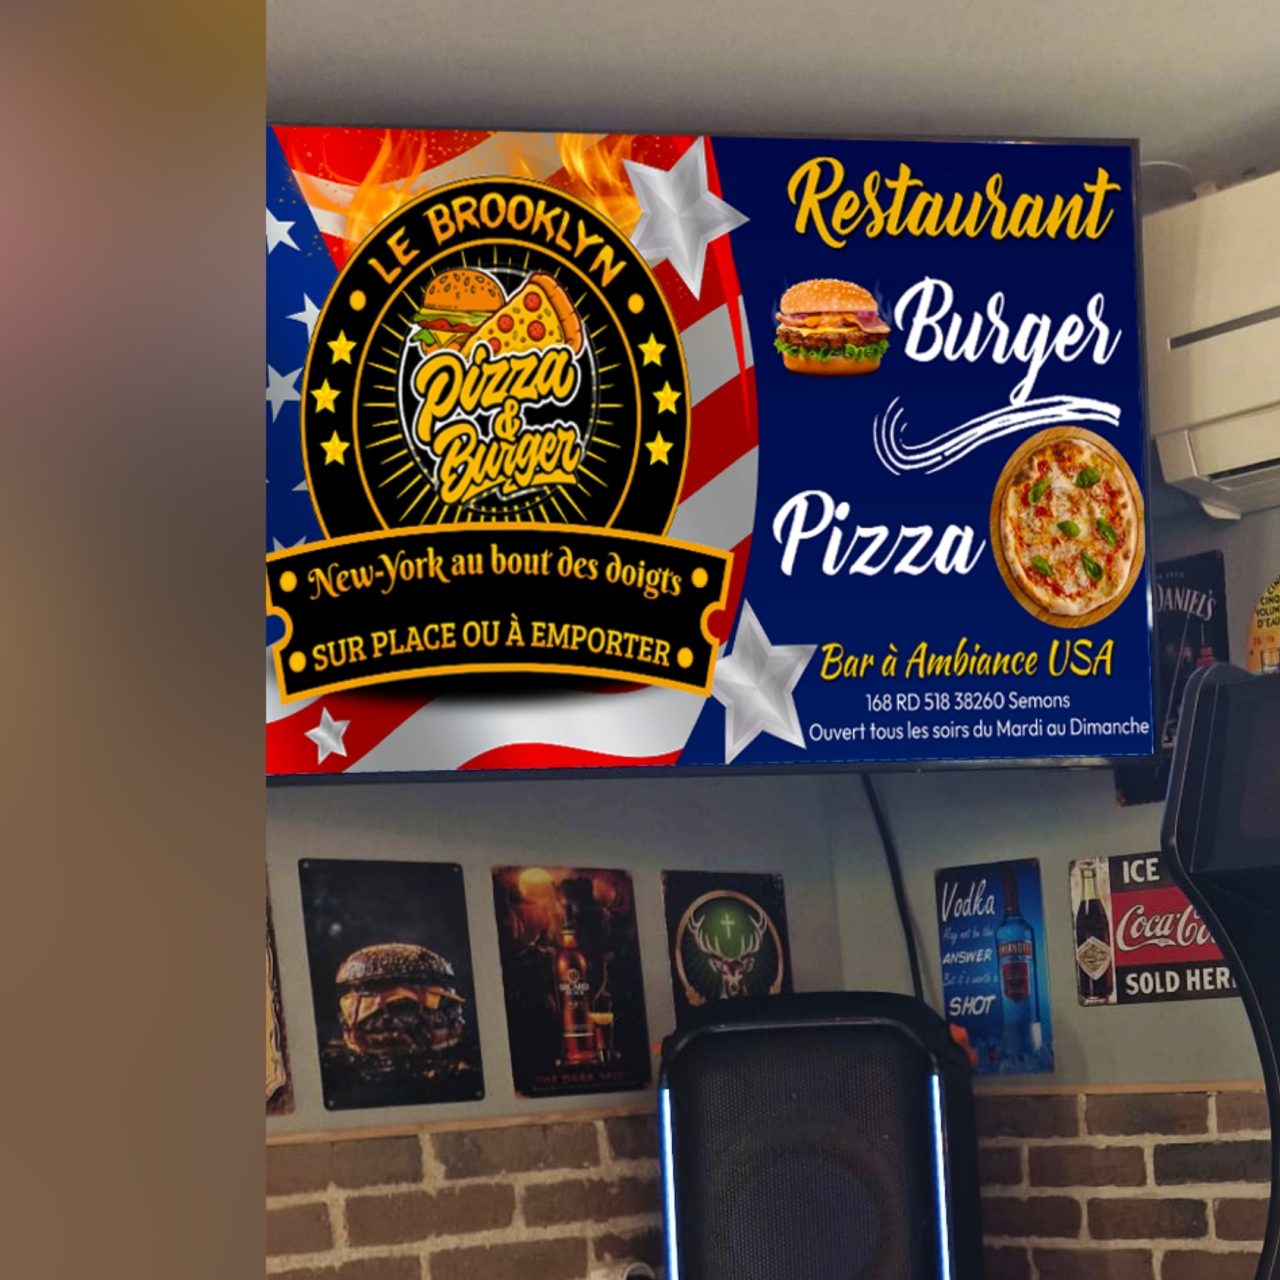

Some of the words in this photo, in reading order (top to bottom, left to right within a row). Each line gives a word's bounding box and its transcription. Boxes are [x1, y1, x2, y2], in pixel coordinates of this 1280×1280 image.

[786, 156, 1122, 249] Restaurant
[368, 227, 419, 284] LE
[423, 193, 627, 288] BROOKLYN
[893, 276, 1122, 405] Burger
[413, 341, 576, 442] Pizza
[494, 399, 522, 439] &
[432, 422, 582, 503] Burger
[772, 489, 987, 577] Pizza
[307, 547, 452, 600] New-York
[451, 551, 485, 577] au
[490, 544, 554, 576] bout
[557, 546, 600, 582] des
[605, 552, 683, 600] doigts
[312, 636, 368, 671] SUR
[371, 621, 456, 660] PLACE
[462, 621, 501, 648] OU
[505, 613, 526, 648] À
[530, 621, 672, 667] EMPORTER
[819, 641, 876, 682] Bar
[878, 646, 899, 679] à
[904, 636, 1039, 680] Ambiance
[1047, 638, 1115, 678] USA
[865, 693, 893, 713] 168
[895, 693, 921, 712] RD
[923, 692, 951, 712] 518
[953, 691, 1005, 712] 38260
[1008, 691, 1071, 710] Semons
[808, 722, 866, 742] Ouvert
[869, 723, 904, 741] tous
[906, 721, 930, 740] les
[932, 720, 971, 739] soirs
[972, 719, 994, 738] du
[996, 718, 1044, 738] Mardi
[1046, 721, 1067, 737] au
[1070, 716, 1150, 737] Dimanche
[1122, 857, 1160, 883] ICE
[942, 878, 996, 922] Vodka
[942, 948, 993, 965] ANSWER
[1125, 971, 1180, 996] SOLD
[1186, 966, 1238, 992] HER
[949, 994, 997, 1016] SHOT
